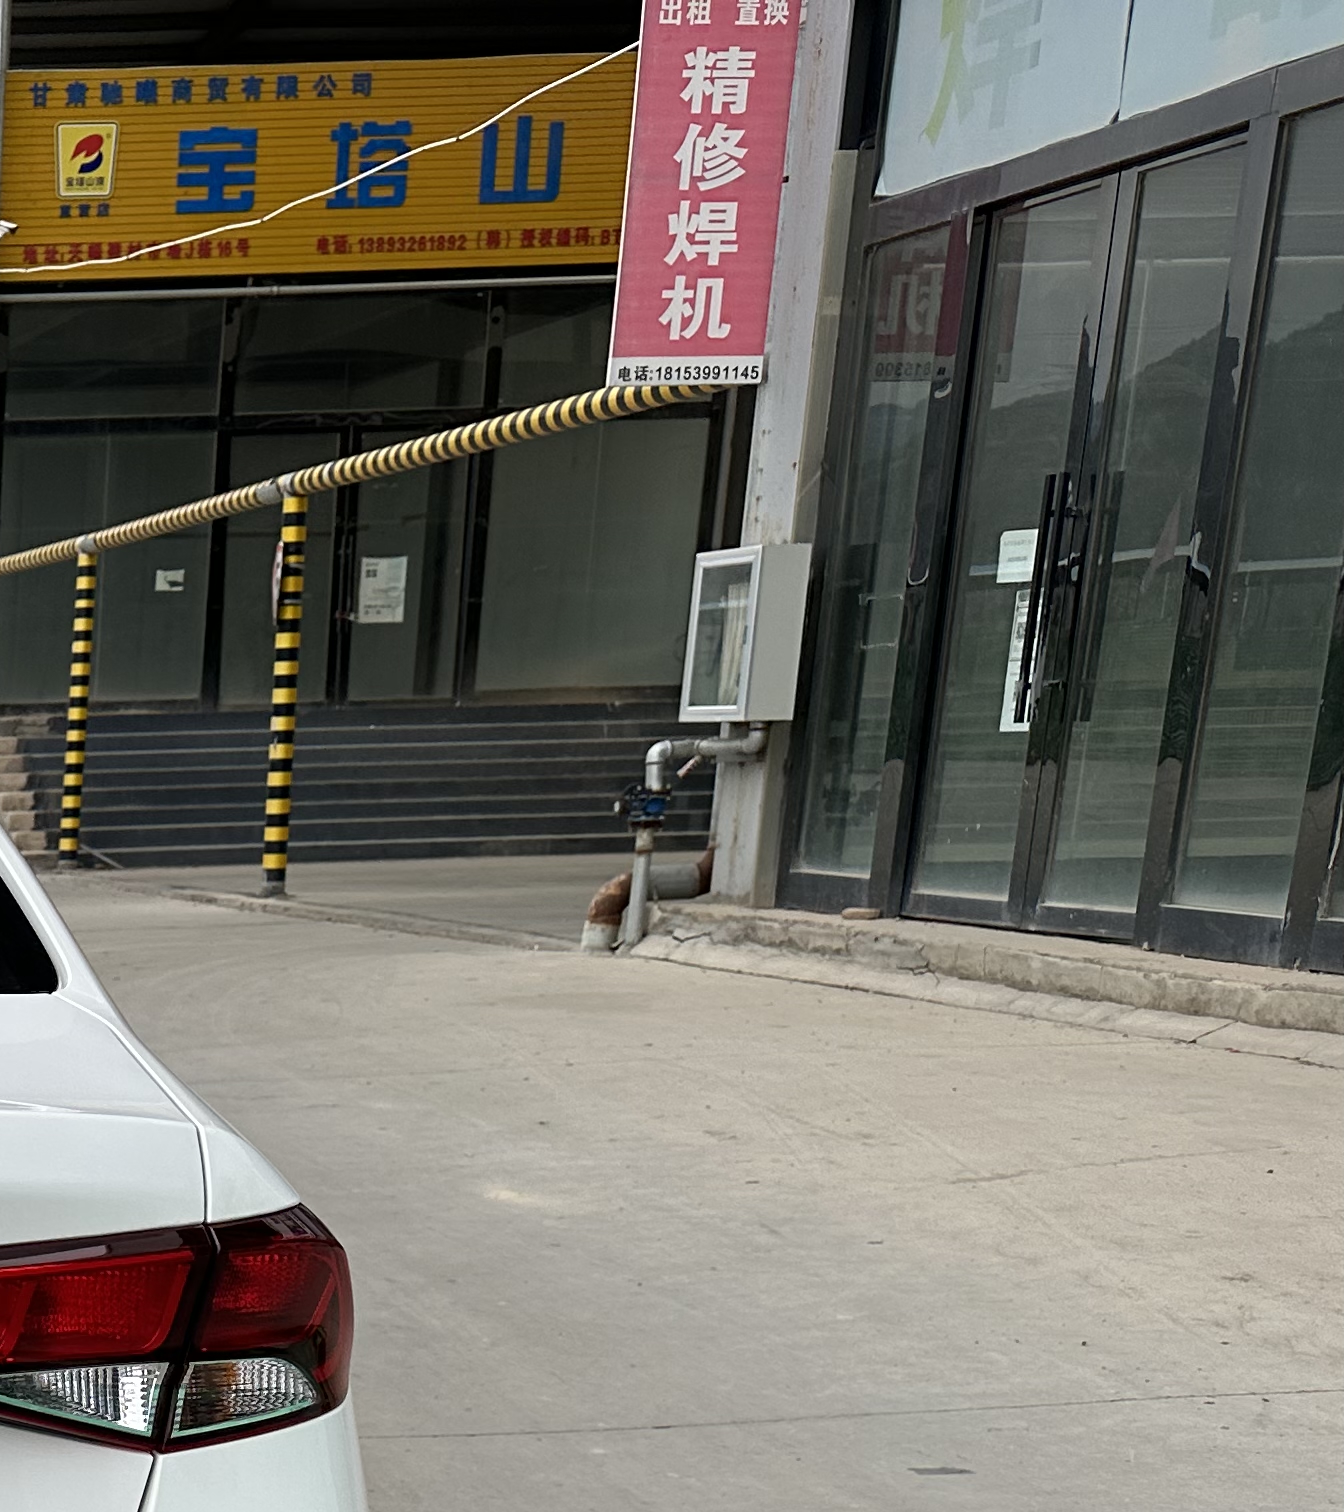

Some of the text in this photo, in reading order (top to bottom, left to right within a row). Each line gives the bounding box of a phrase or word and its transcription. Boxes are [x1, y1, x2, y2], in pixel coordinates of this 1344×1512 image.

[658, 0, 790, 25] 出租 置换
[175, 115, 565, 214] 宝塔山
[658, 46, 756, 341] 精修焊机
[617, 365, 760, 382] 电话:18153991145
